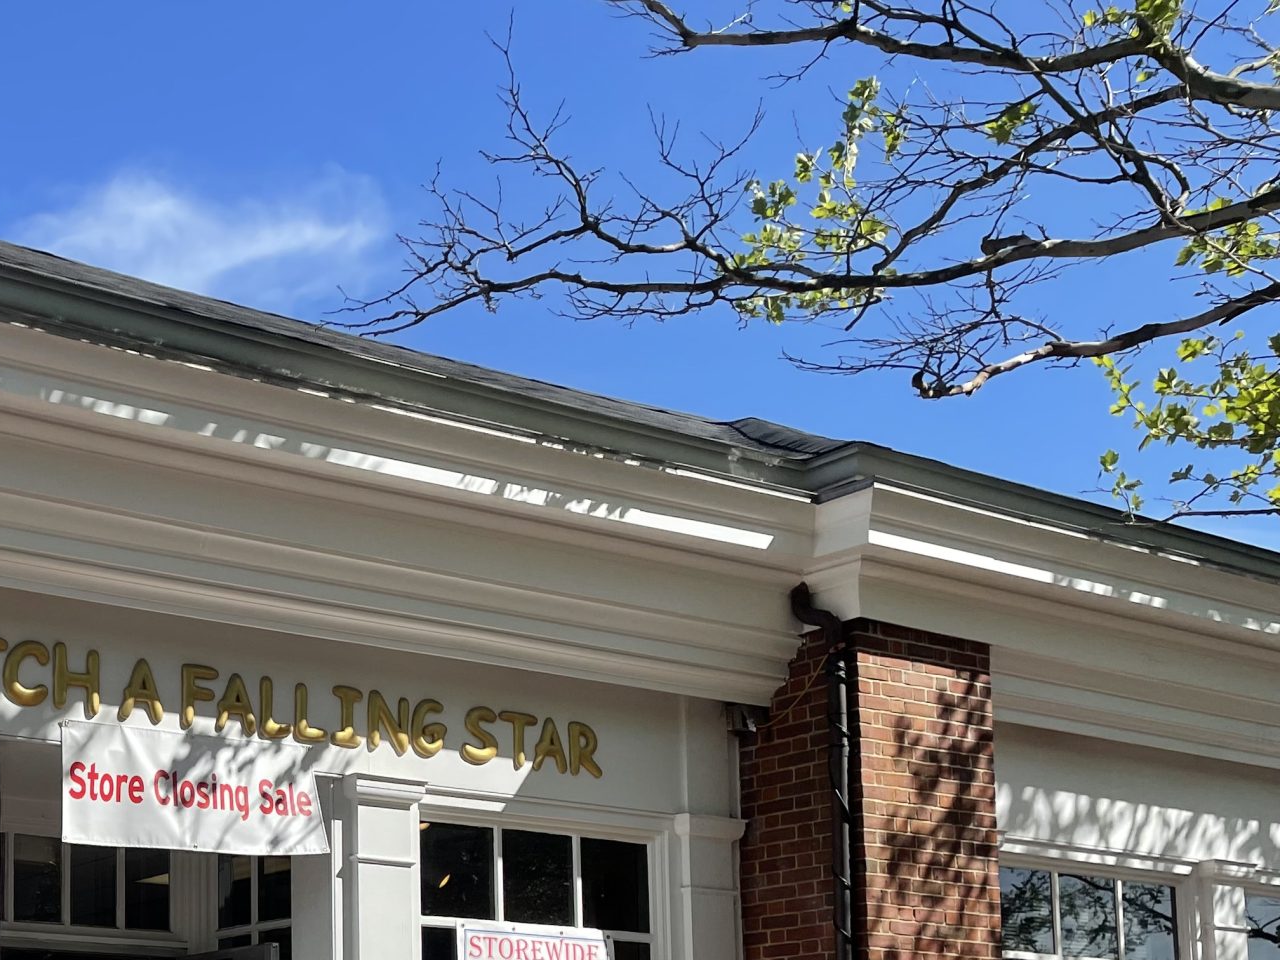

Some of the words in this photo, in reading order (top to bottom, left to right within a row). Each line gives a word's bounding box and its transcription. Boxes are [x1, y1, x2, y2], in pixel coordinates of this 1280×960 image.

[118, 658, 163, 724] A
[180, 664, 445, 757] FALLING
[460, 706, 604, 779] STAR
[68, 760, 144, 805] Store
[153, 771, 250, 822] Closing
[258, 779, 313, 818] Sale
